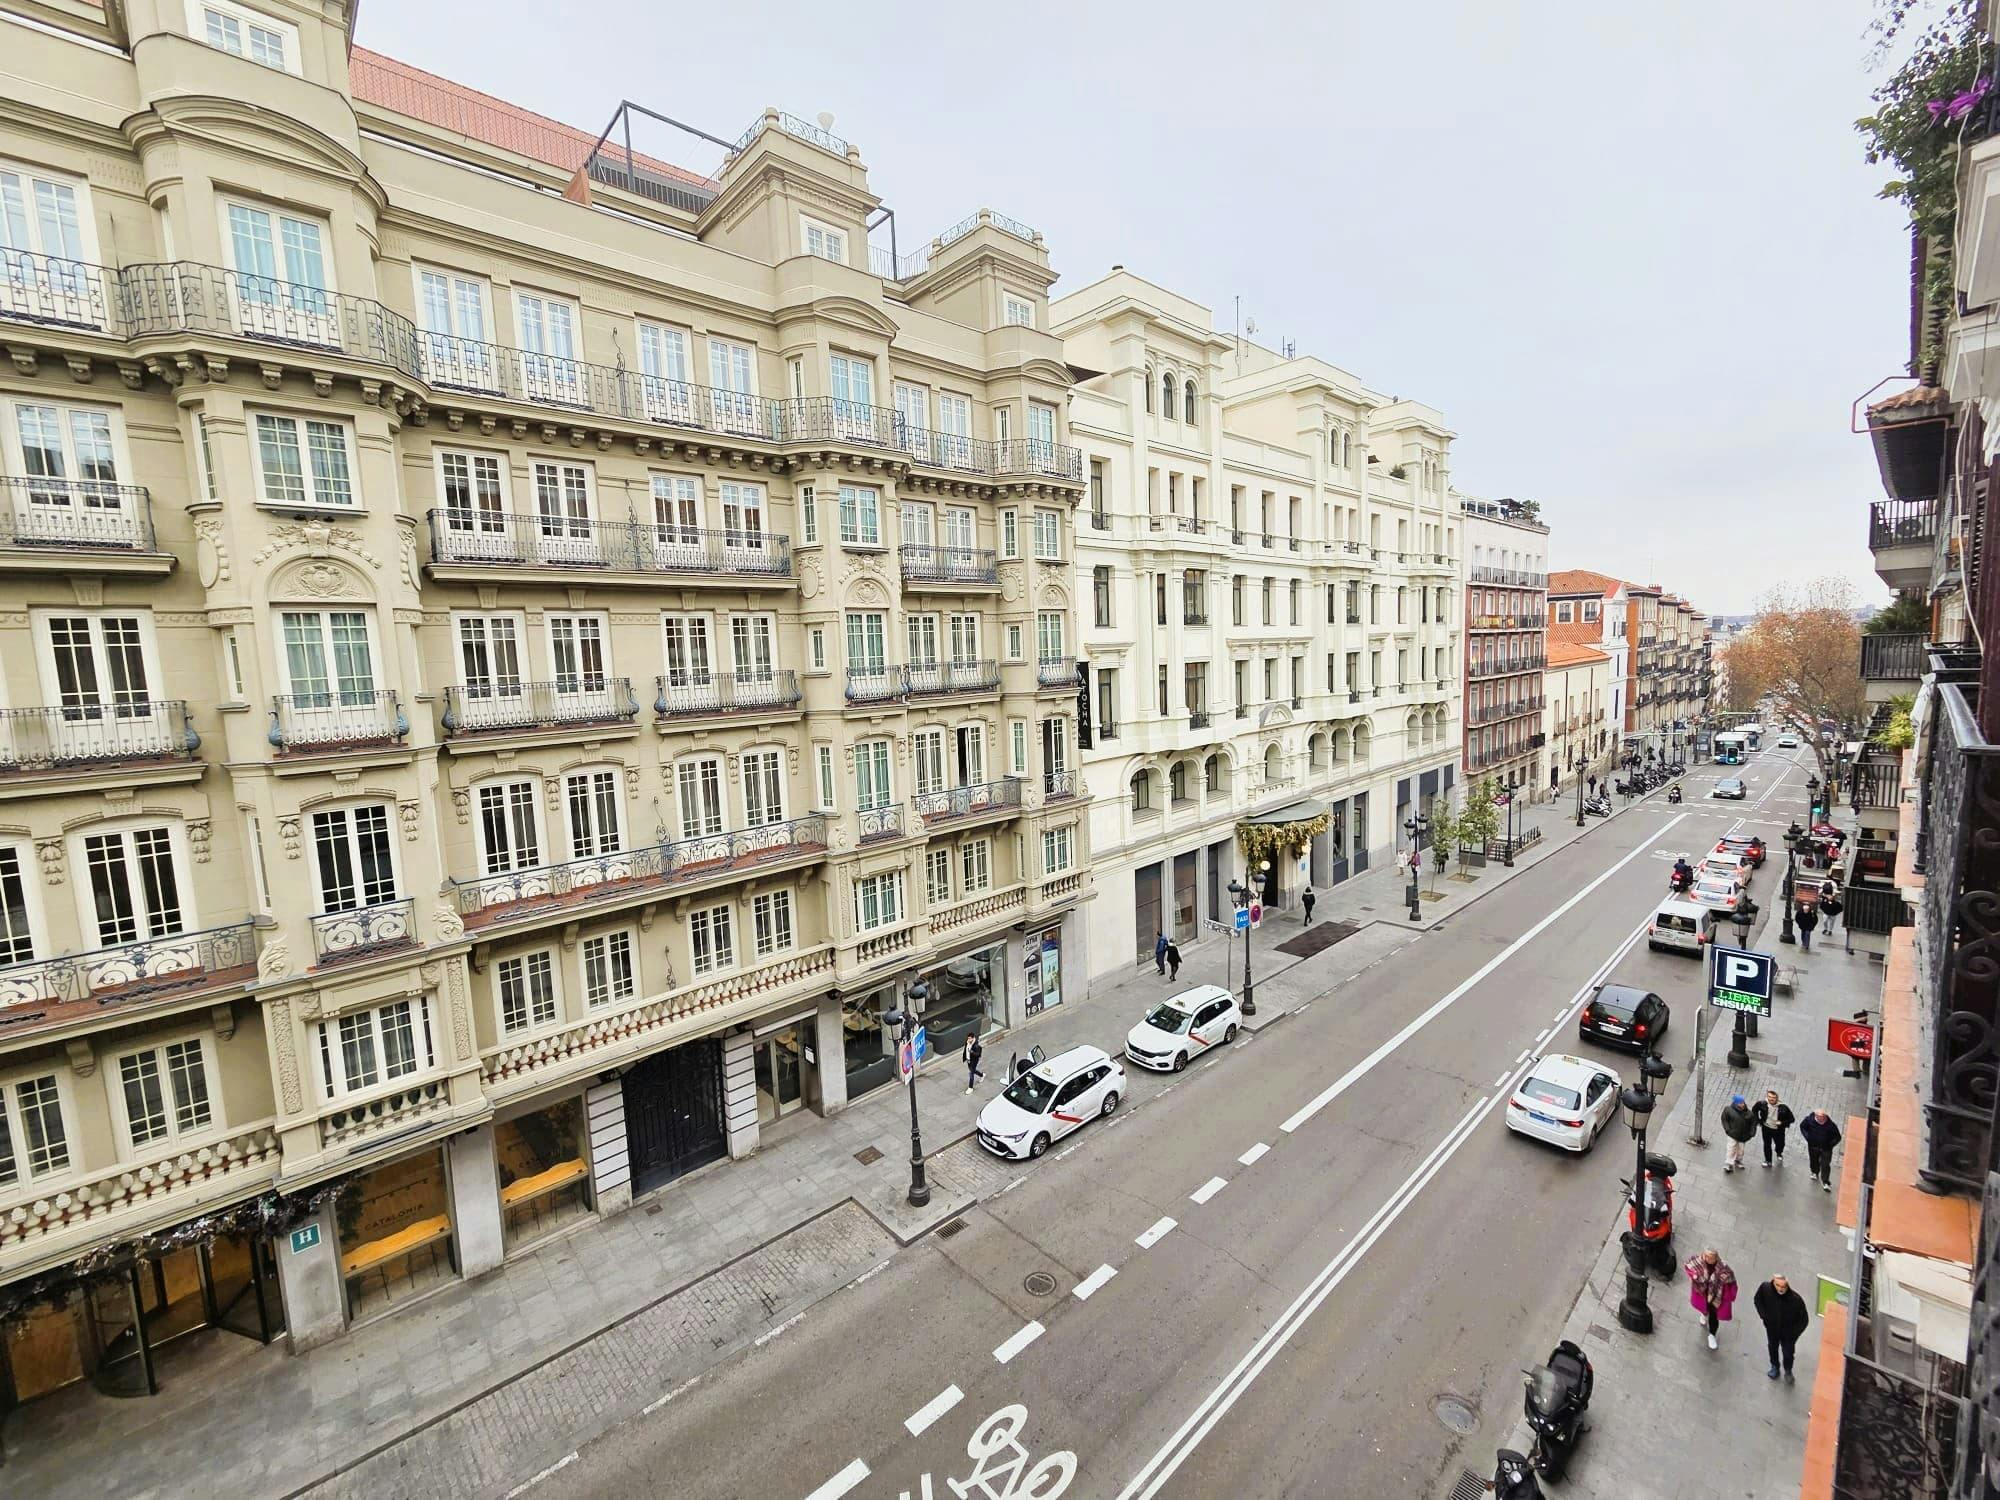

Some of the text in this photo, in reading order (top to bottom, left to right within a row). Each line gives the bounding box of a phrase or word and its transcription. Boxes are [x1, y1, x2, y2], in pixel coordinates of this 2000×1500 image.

[1726, 956, 1759, 986] P
[1718, 990, 1761, 1006] LIBRE
[365, 1203, 425, 1231] CATALONIA
[299, 1229, 312, 1245] H
